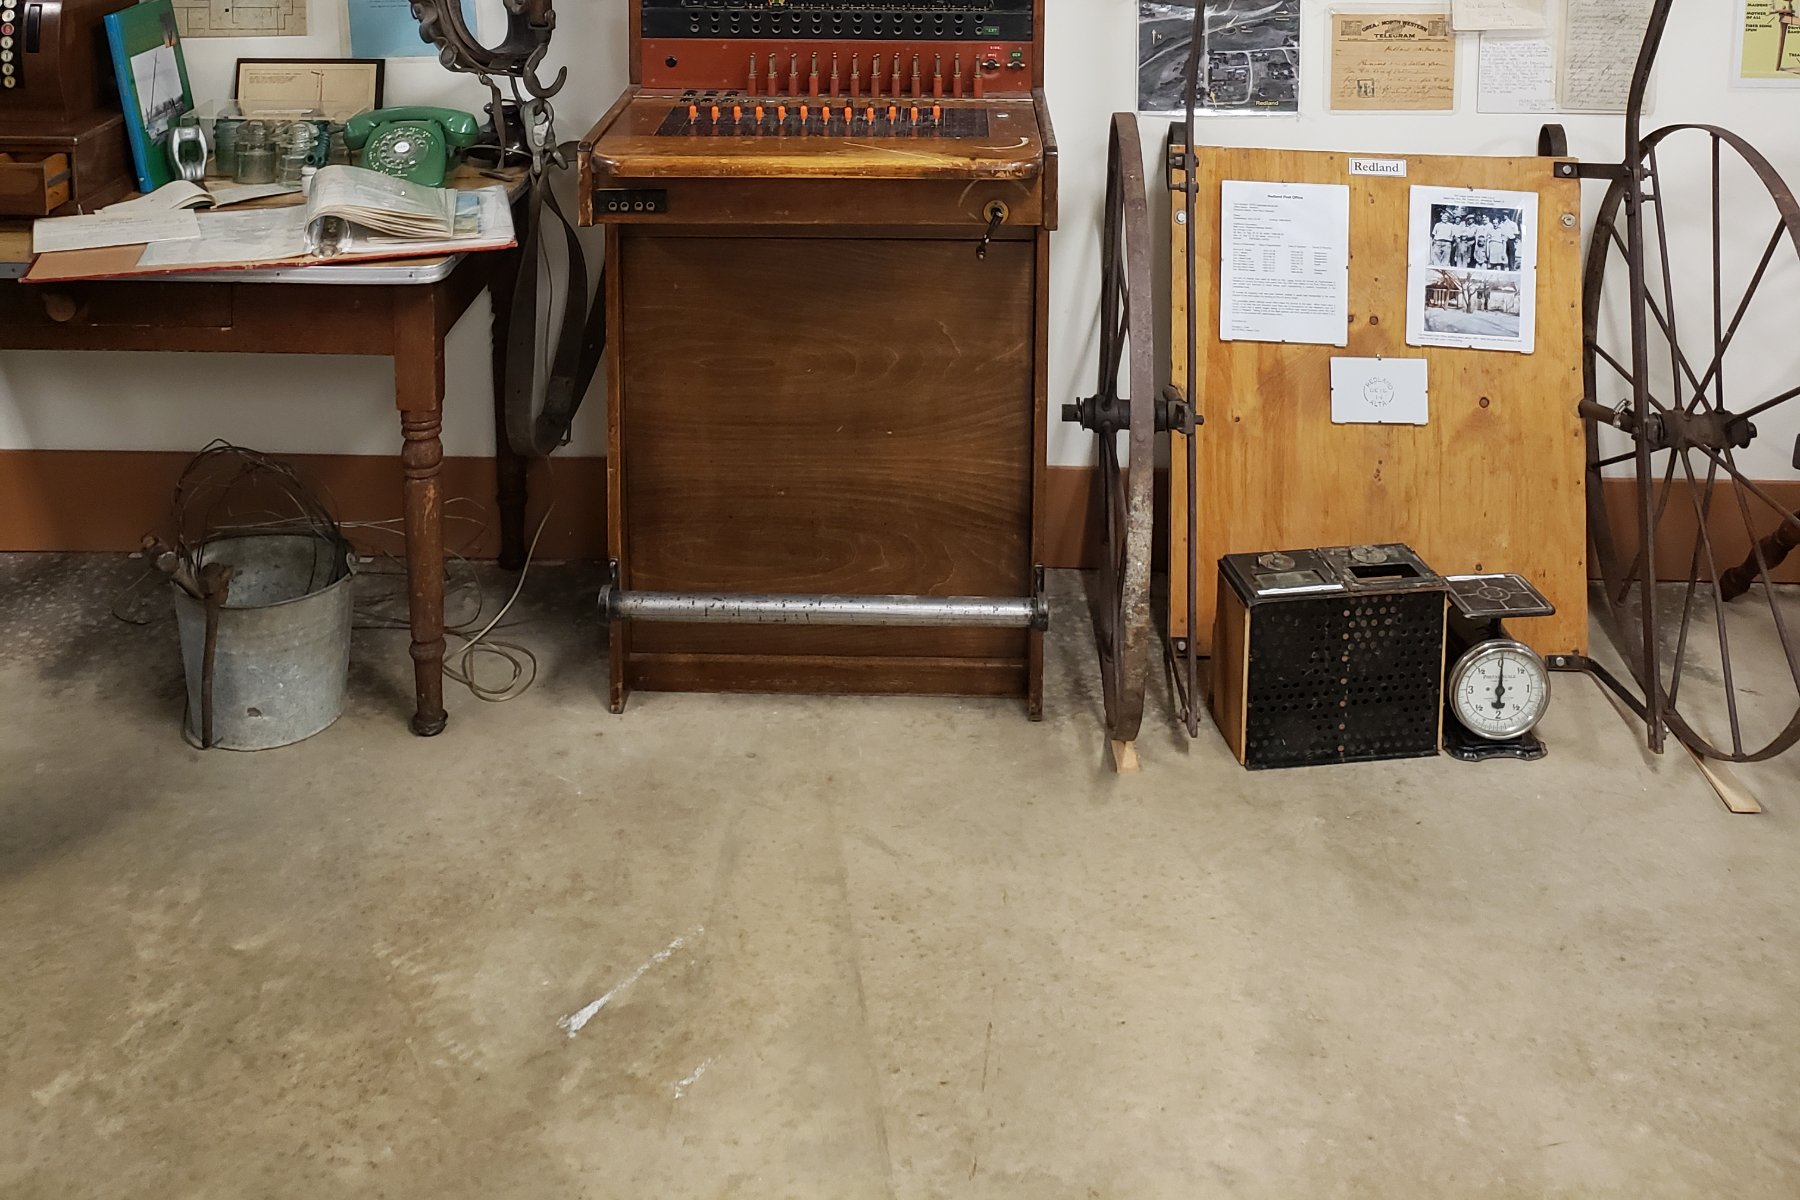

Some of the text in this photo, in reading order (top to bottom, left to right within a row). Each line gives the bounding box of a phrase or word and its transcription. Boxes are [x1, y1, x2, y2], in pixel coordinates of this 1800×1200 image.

[1362, 24, 1380, 32] GREA
[1402, 20, 1428, 32] WESTERN
[1354, 162, 1399, 172] Redland
[1468, 686, 1474, 694] 3
[1526, 684, 1529, 693] 1
[1495, 711, 1501, 719] 2
